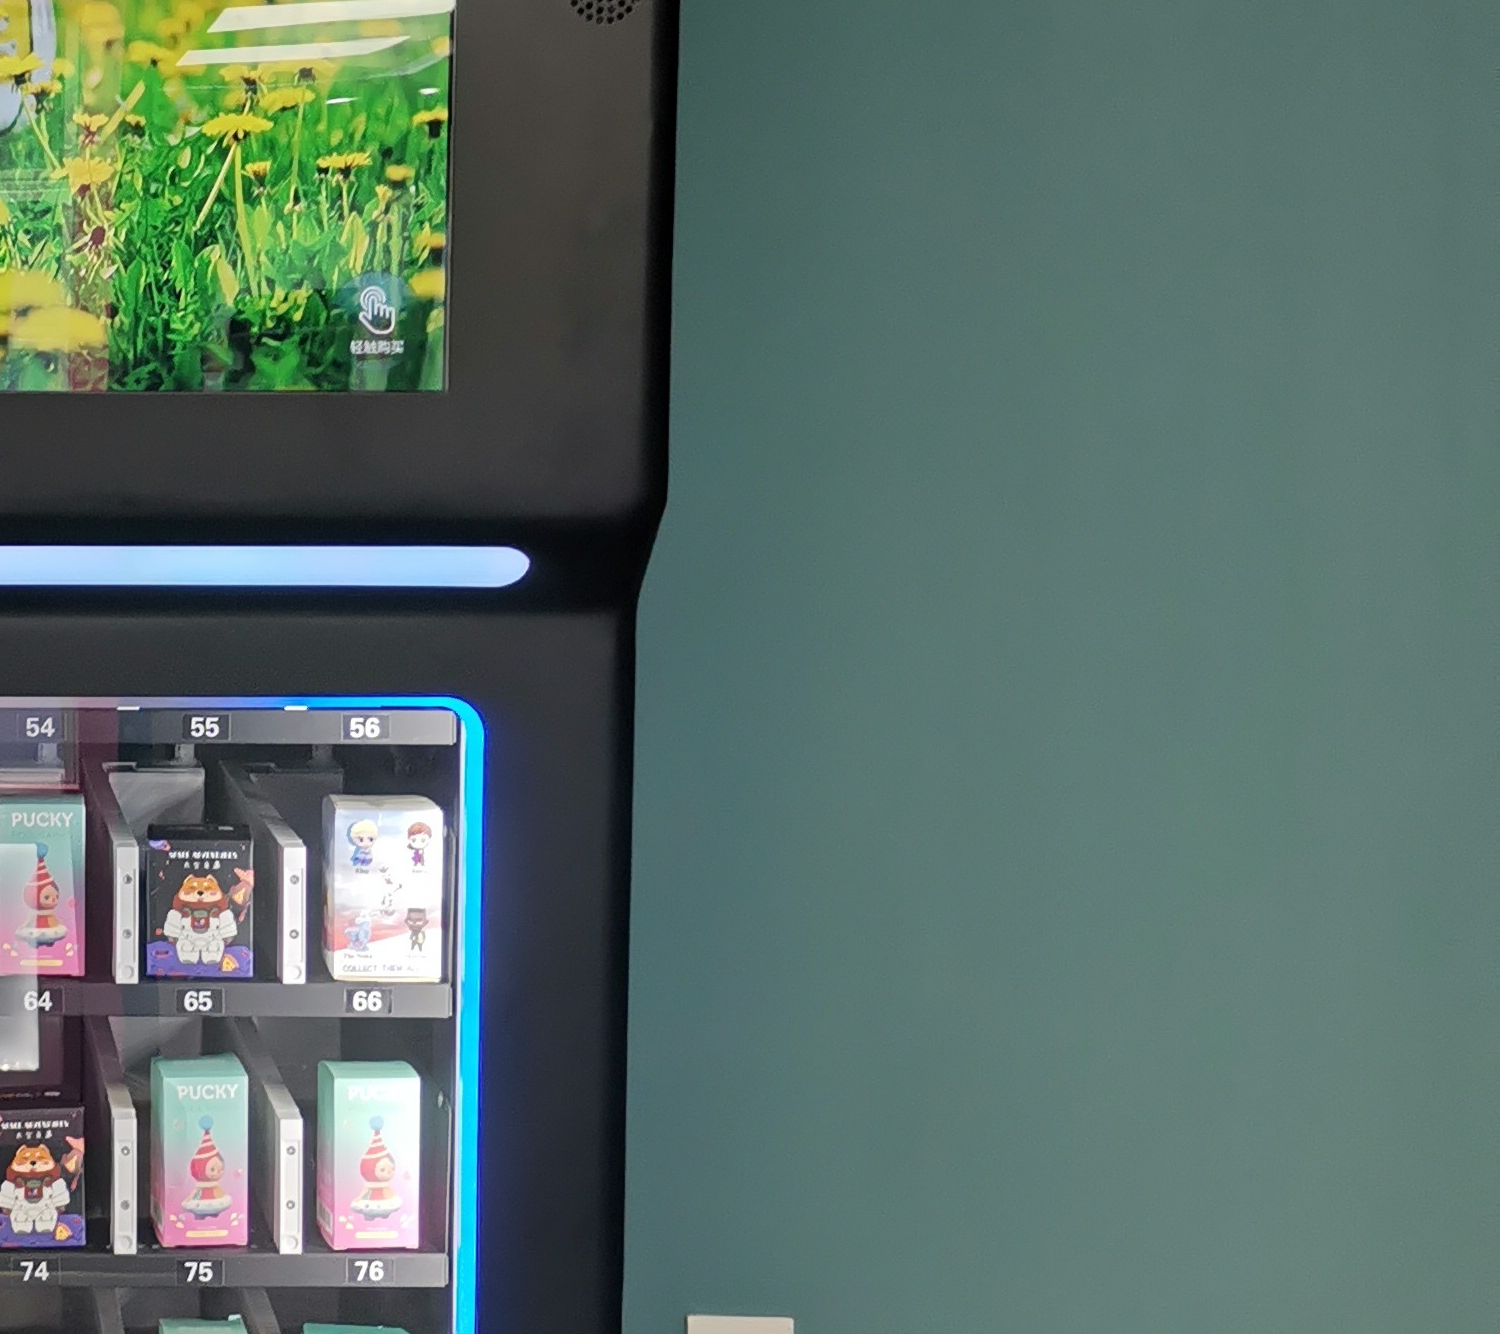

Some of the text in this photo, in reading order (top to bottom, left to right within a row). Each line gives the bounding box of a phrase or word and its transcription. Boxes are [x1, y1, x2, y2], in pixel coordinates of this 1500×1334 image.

[25, 717, 55, 738] 54
[190, 717, 220, 738] 55
[349, 717, 380, 739] 56
[11, 811, 74, 828] PUCKY
[23, 991, 53, 1012] 64
[183, 990, 213, 1012] 65
[352, 991, 382, 1012] 66
[176, 1083, 239, 1101] PUCKY
[347, 1084, 407, 1101] PUC
[20, 1261, 49, 1282] 74
[184, 1261, 213, 1282] 75
[354, 1261, 384, 1282] 76
